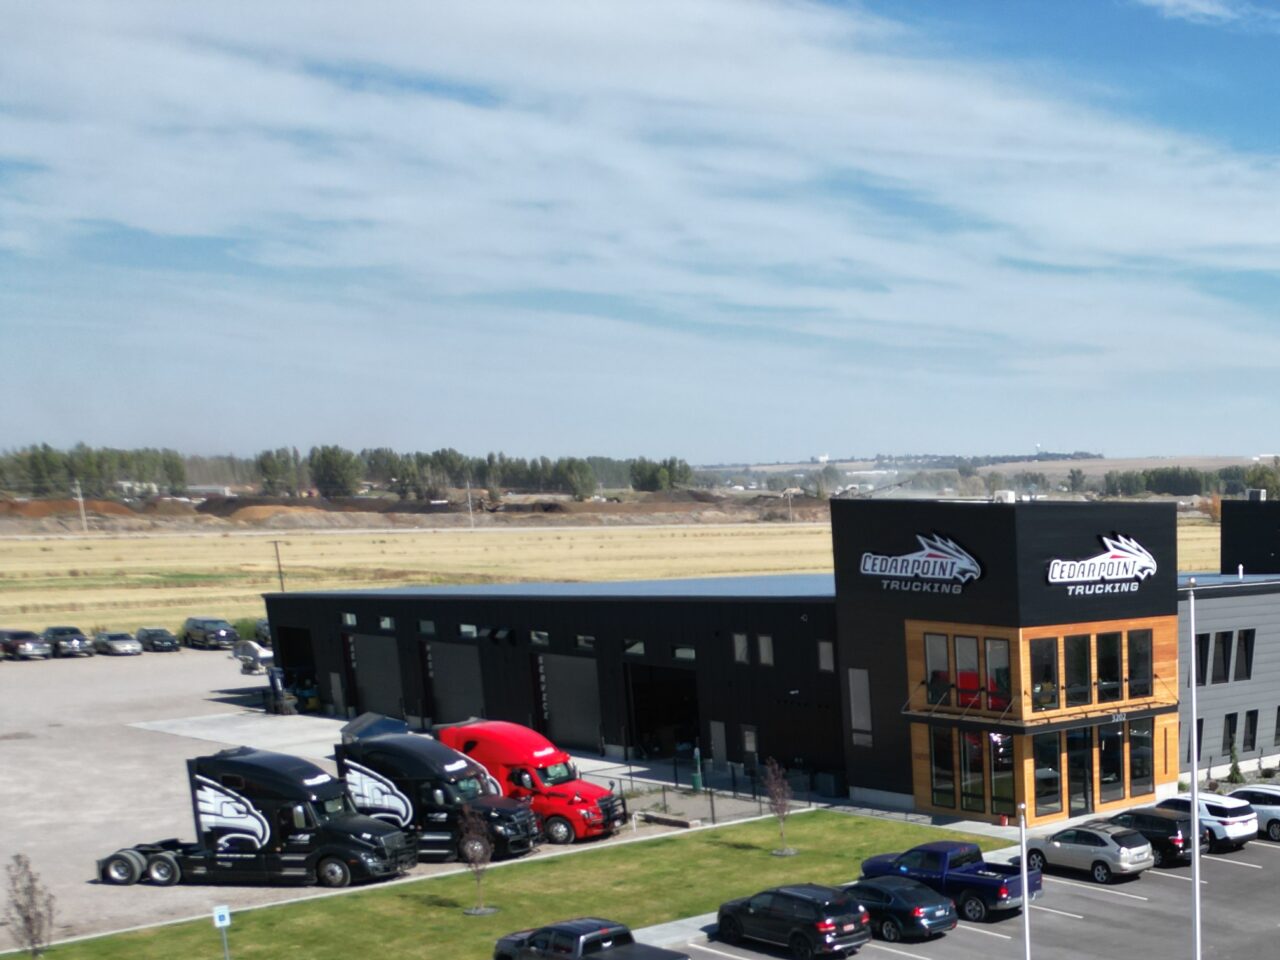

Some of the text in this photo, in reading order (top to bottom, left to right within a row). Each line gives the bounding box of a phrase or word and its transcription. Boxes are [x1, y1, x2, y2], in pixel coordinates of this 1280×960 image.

[862, 554, 958, 578] CEDARPOINT
[1050, 560, 1137, 580] CEDARPOINT
[881, 580, 963, 594] TRUCKING
[1067, 582, 1140, 596] TRUCKING
